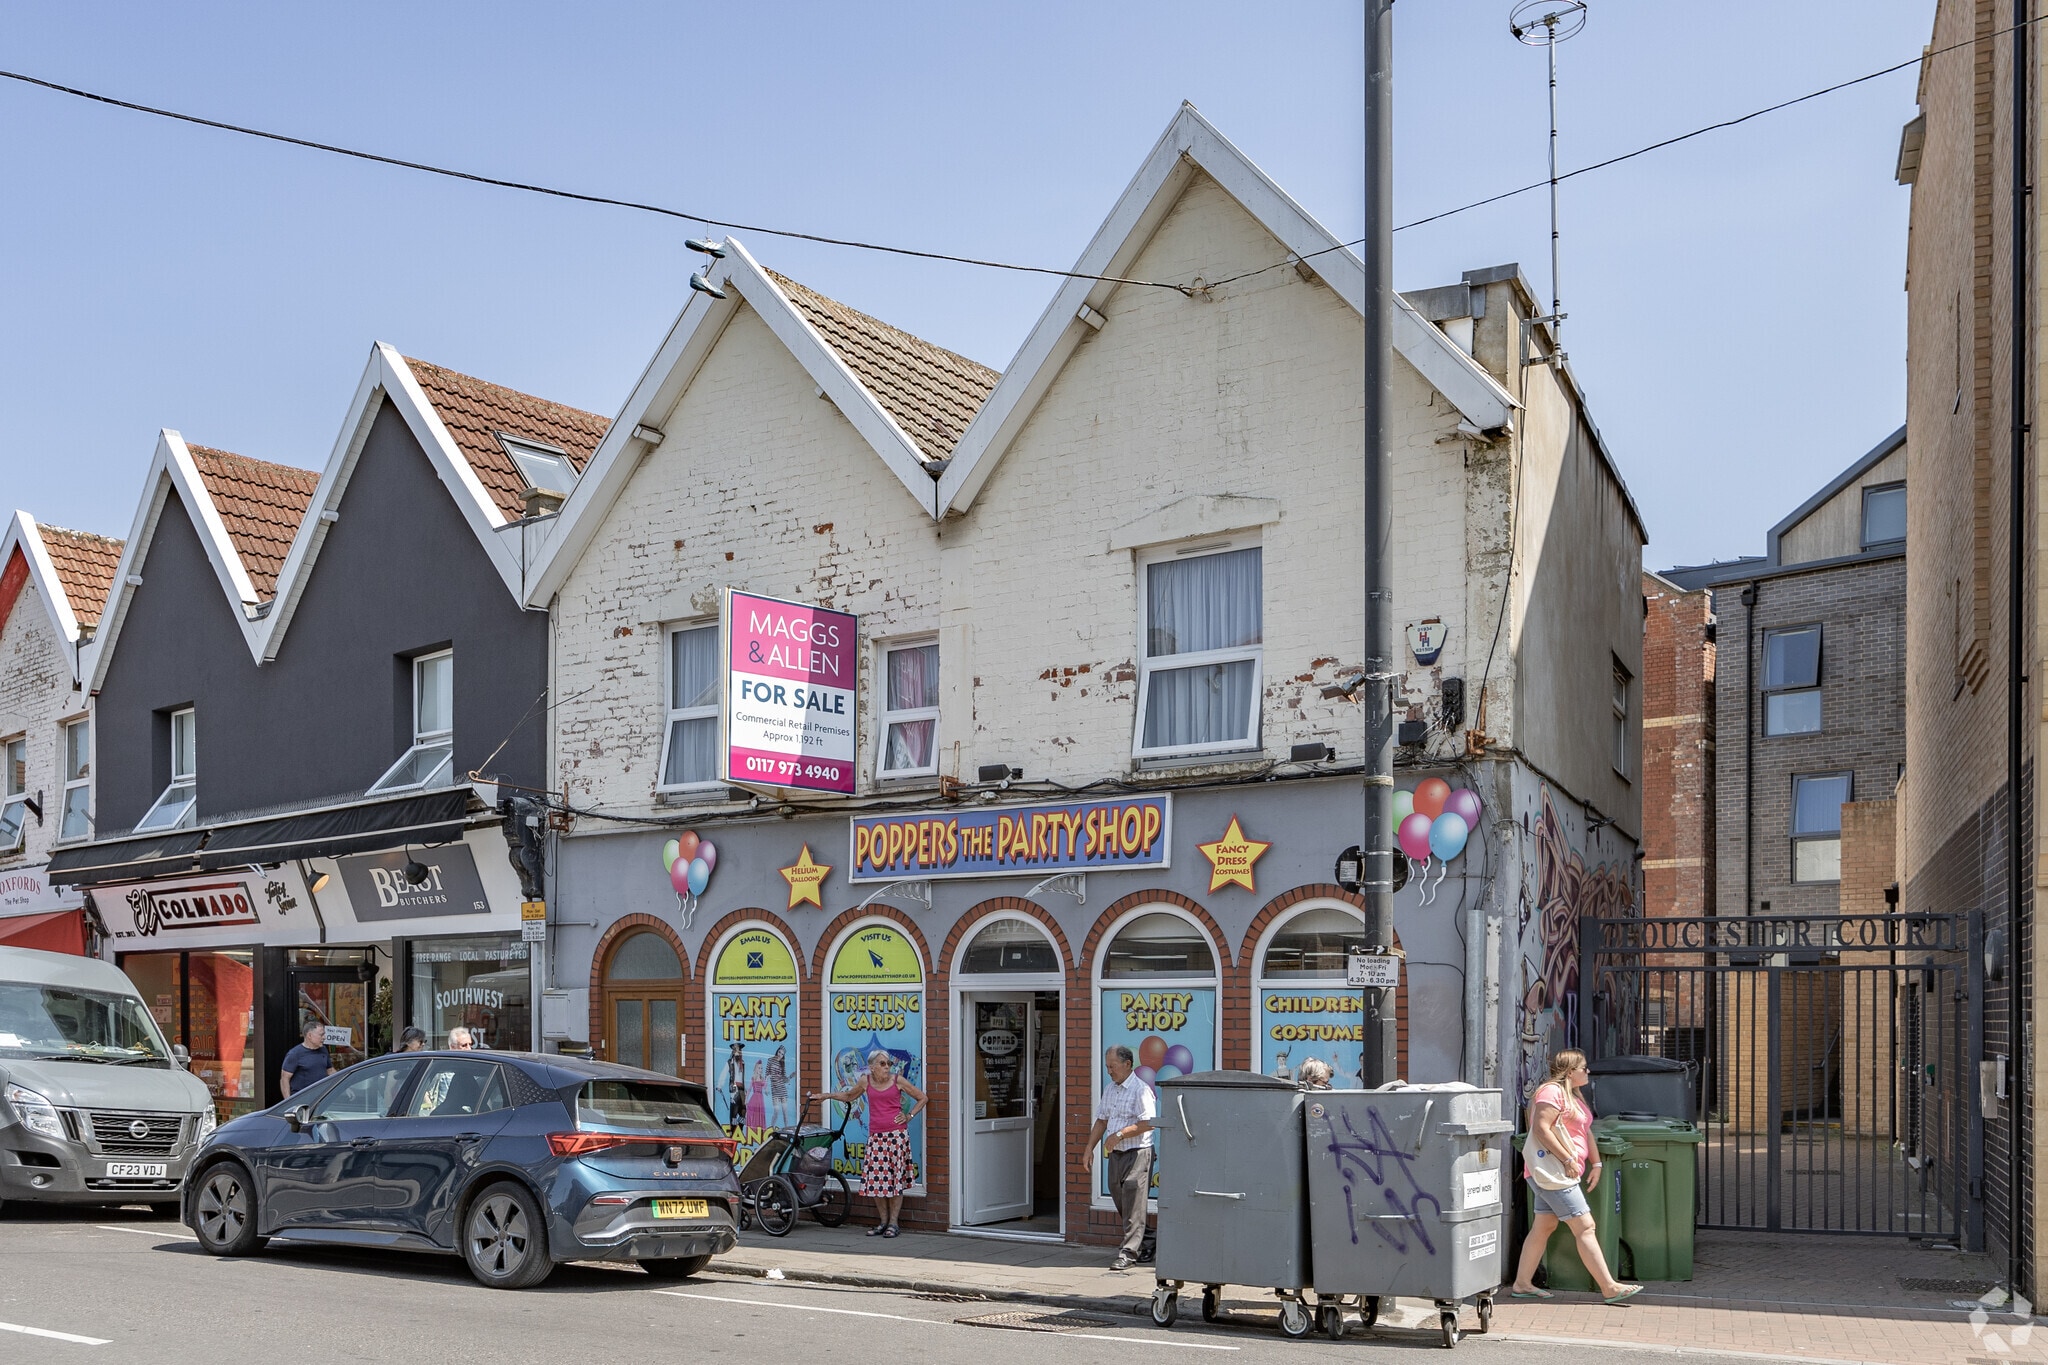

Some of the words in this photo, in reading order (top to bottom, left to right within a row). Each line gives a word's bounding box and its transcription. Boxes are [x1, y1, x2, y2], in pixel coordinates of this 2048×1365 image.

[750, 610, 840, 647] MAGGS
[749, 640, 765, 664] &
[768, 643, 839, 677] ALLEN
[742, 680, 787, 706] FOR
[793, 688, 845, 715] SALE
[736, 711, 786, 727] Commercial
[788, 719, 812, 732] Retail
[814, 723, 850, 737] Premises
[763, 730, 793, 743] Approx
[816, 737, 823, 746] ft
[746, 756, 776, 773] 0117
[778, 760, 802, 776] 973
[805, 764, 840, 781] 4940
[856, 817, 959, 870] POPPERS
[961, 825, 994, 860] THE
[997, 809, 1083, 862] PARTY
[1084, 804, 1162, 857] SHOP
[1216, 844, 1249, 854] FANCY
[1217, 856, 1247, 866] DRESS
[790, 875, 820, 883] BALLOONS
[791, 867, 818, 875] HELIUM
[158, 893, 249, 920] COLMADO
[400, 894, 448, 907] BUTCHERS
[473, 900, 485, 910] 153
[740, 935, 761, 946] EMAIL
[761, 935, 771, 945] US
[860, 932, 881, 943] VISIT
[881, 934, 892, 943] US
[1600, 920, 1815, 948] GLOUCESTER
[1836, 918, 1955, 946] COURT
[416, 952, 452, 963] FREE-RANGE
[460, 950, 479, 961] LOCAL
[1367, 957, 1391, 965] loading
[436, 987, 504, 1010] SOUTHWEST
[719, 994, 791, 1018] PARTY
[833, 994, 920, 1013] GREETING
[1121, 992, 1194, 1013] PARTY
[1264, 994, 1363, 1014] CHILDREN
[723, 1019, 788, 1042] ITEMS
[847, 1012, 906, 1032] CARDS
[1126, 1010, 1188, 1032] SHOP
[326, 1034, 346, 1042] OPEN
[982, 1036, 1016, 1045] POPPERS
[1270, 1023, 1363, 1042] COSTUME
[111, 1164, 141, 1176] CF23
[143, 1165, 163, 1176] VDJ
[657, 1201, 686, 1215] WN72
[687, 1201, 705, 1214] UWF
